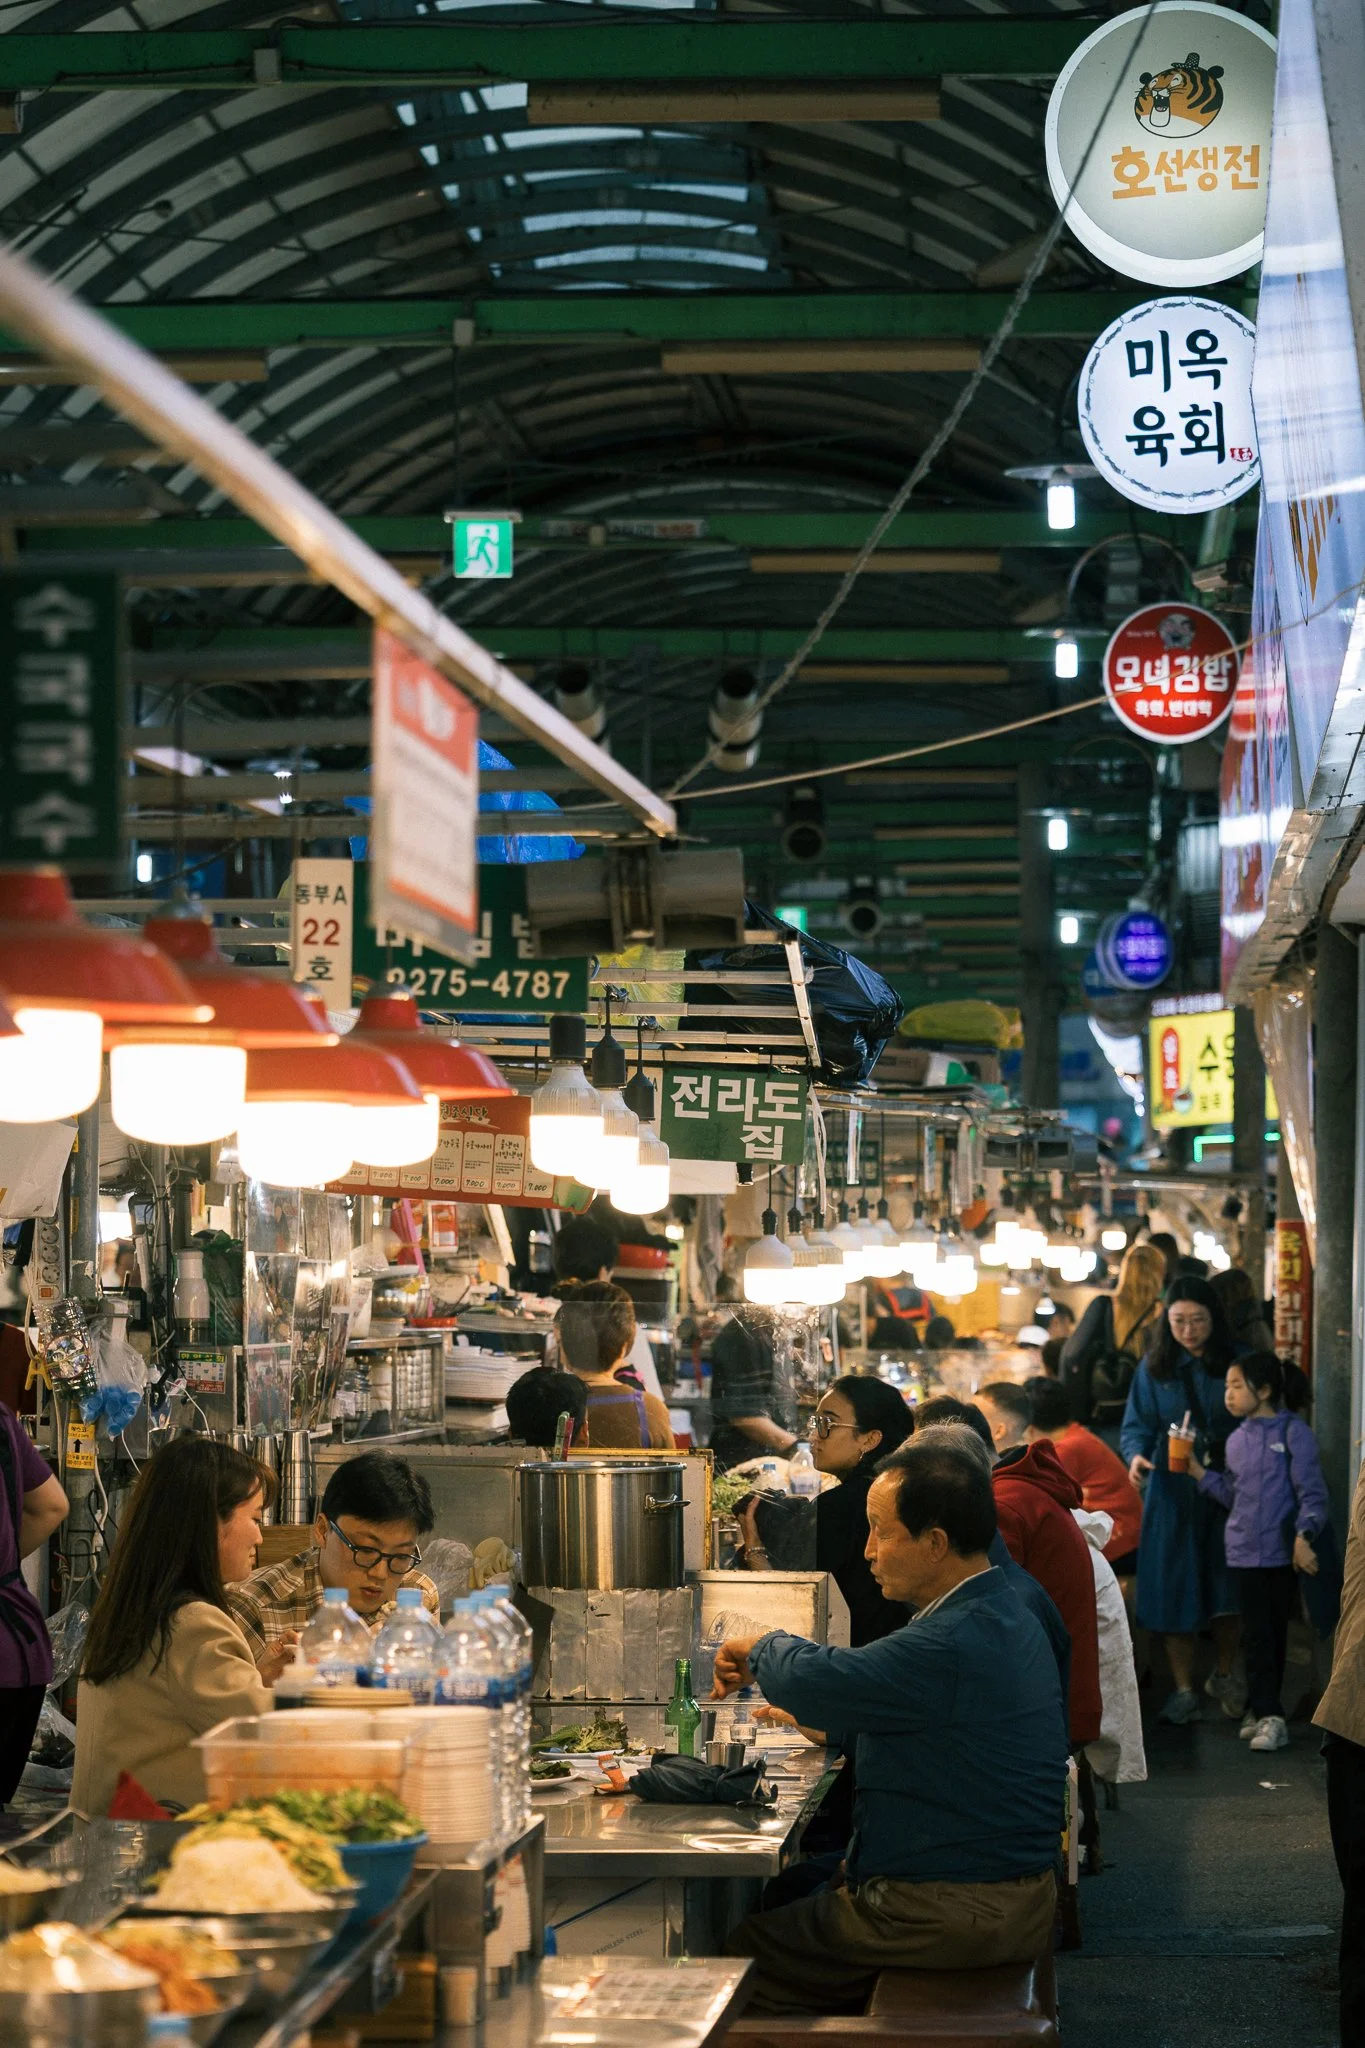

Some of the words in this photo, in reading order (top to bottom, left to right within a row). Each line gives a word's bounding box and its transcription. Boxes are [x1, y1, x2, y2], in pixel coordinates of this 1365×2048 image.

[1111, 144, 1260, 199] 호선생전
[1125, 329, 1228, 392] 미옥
[1125, 401, 1226, 467] 육회
[1114, 653, 1232, 695] 모녀김밥
[302, 918, 341, 946] 22
[306, 956, 334, 982] 호
[670, 1075, 802, 1123] 전라도
[740, 1125, 784, 1161] 집
